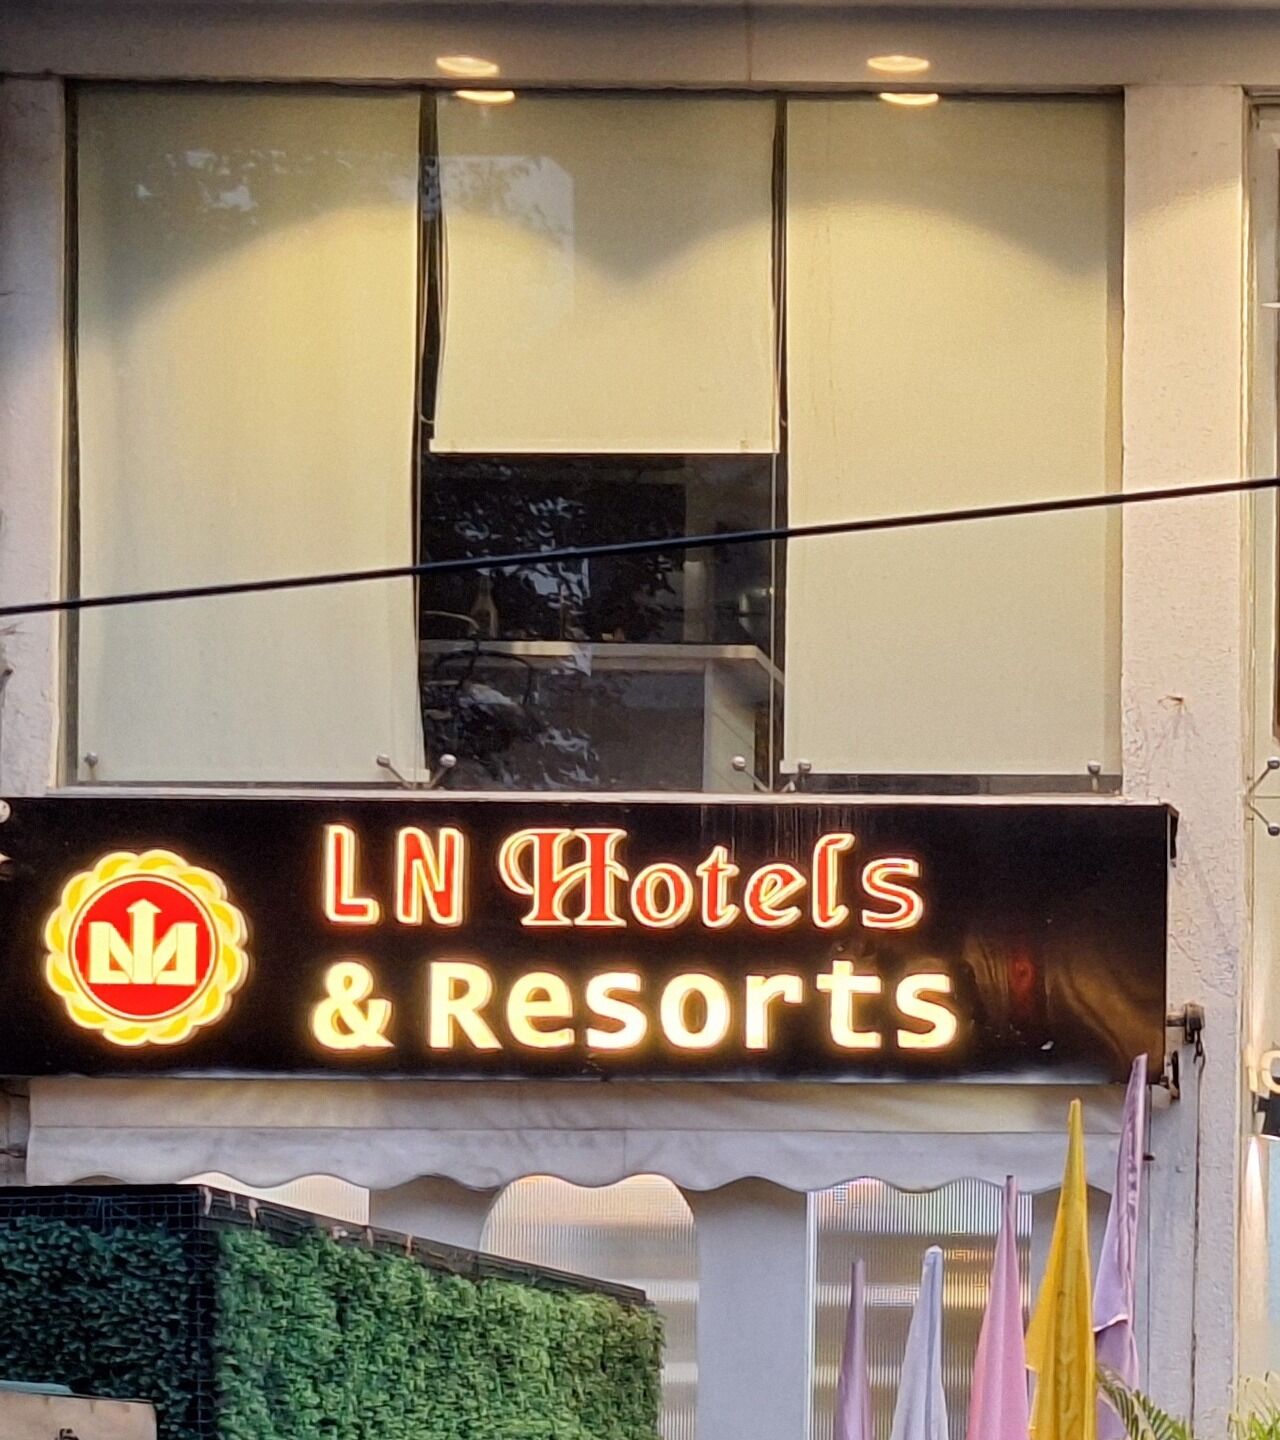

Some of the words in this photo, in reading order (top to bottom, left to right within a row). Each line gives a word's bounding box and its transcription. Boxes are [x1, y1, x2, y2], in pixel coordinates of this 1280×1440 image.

[498, 826, 926, 930] Hotels
[311, 958, 394, 1052] &
[427, 957, 959, 1052] Resorts
